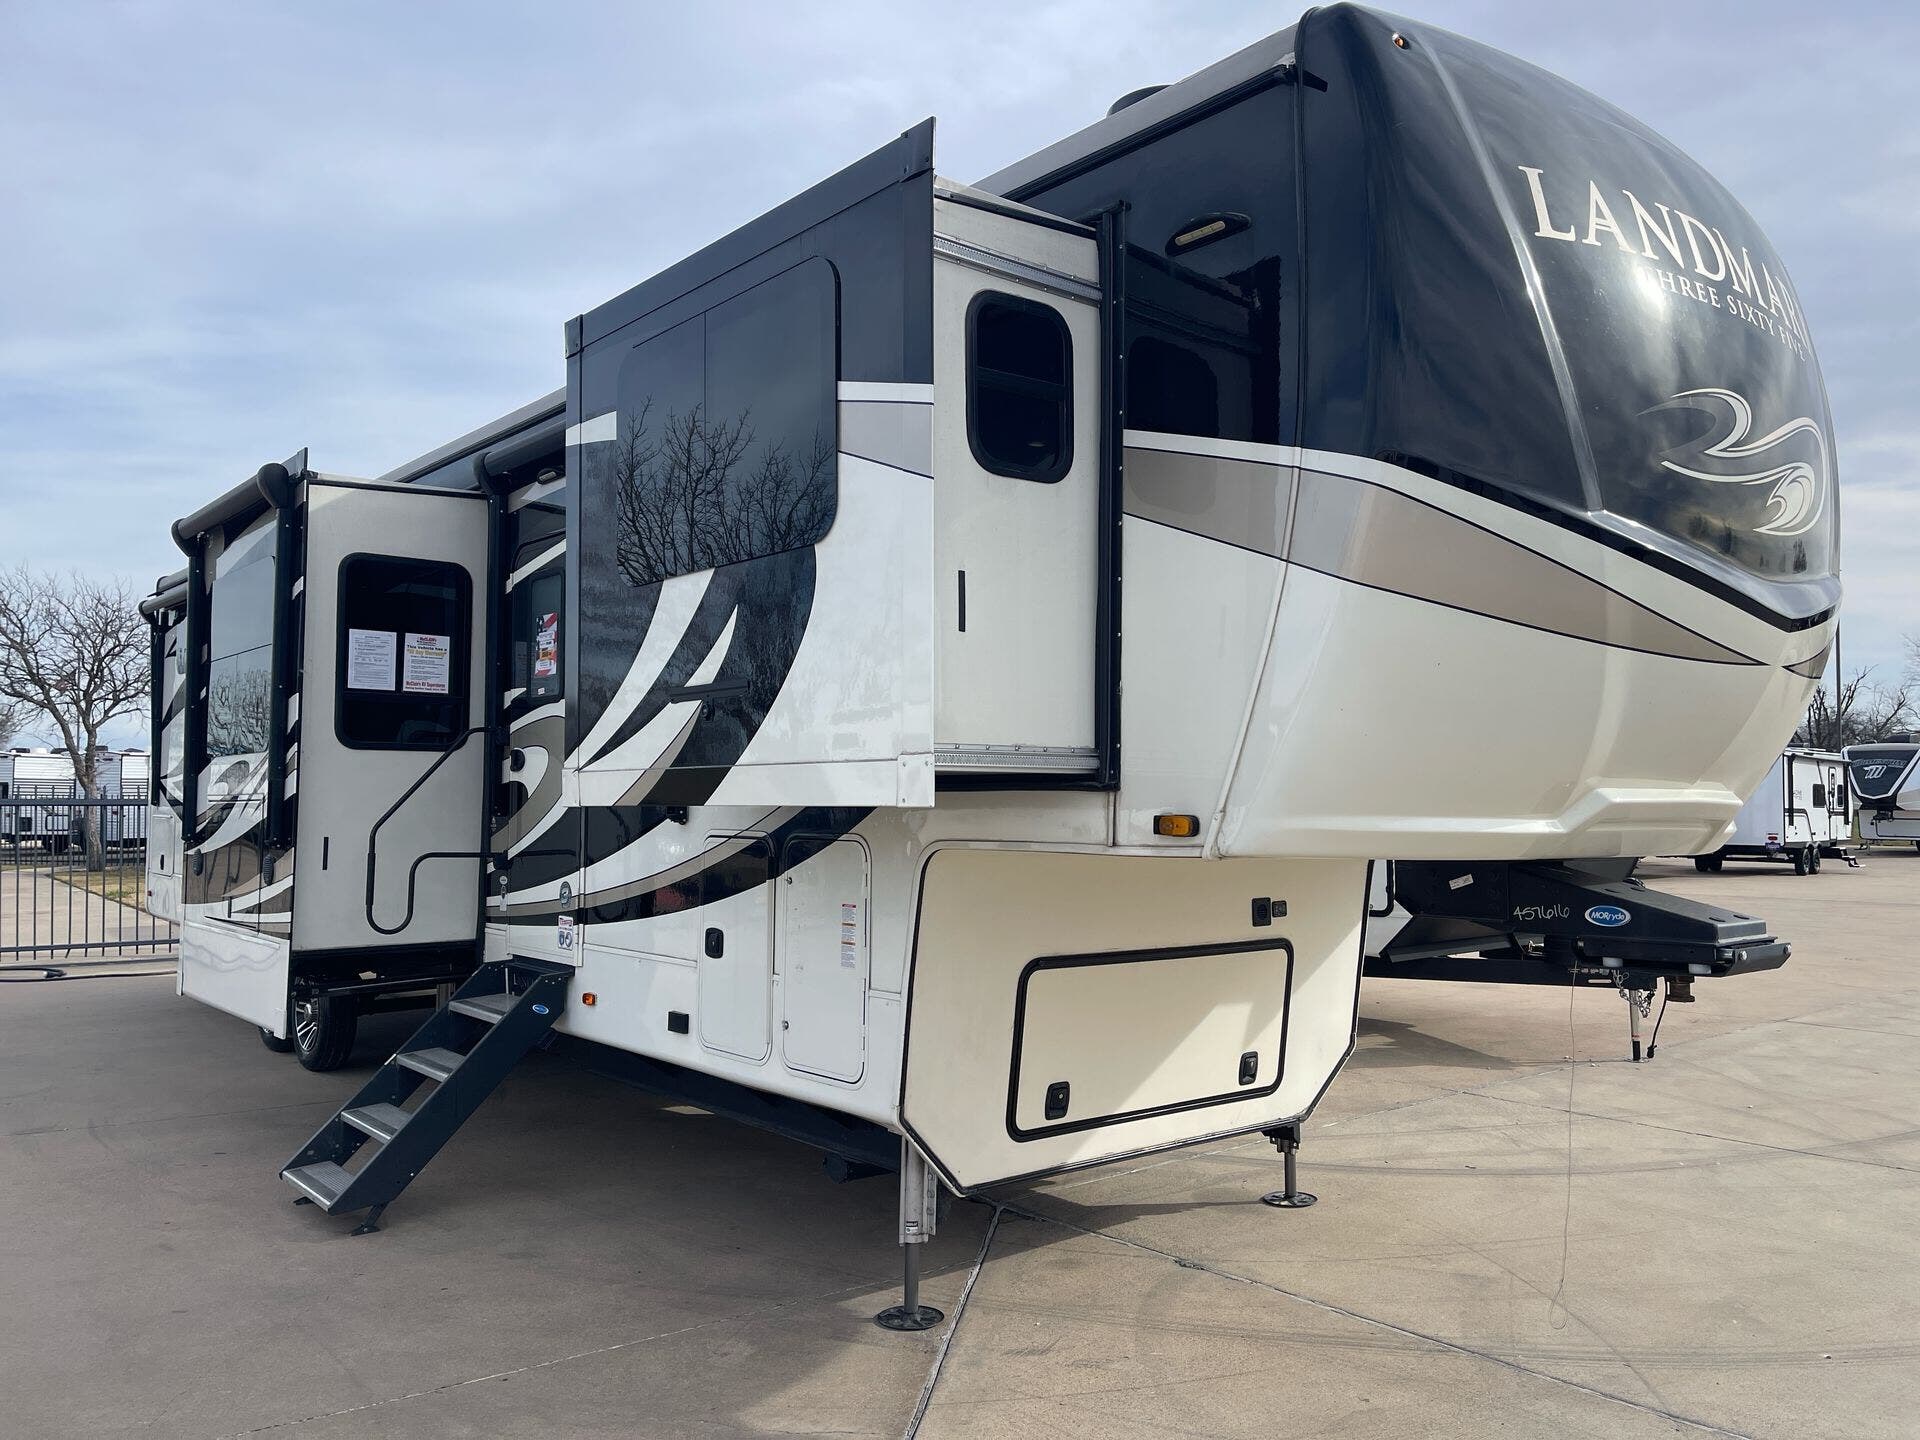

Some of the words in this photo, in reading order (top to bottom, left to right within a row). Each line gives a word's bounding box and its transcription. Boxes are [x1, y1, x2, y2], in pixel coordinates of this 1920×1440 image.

[1645, 266, 1721, 308] HREE
[1726, 295, 1776, 336] SIXTY
[1591, 911, 1625, 920] MORryde
